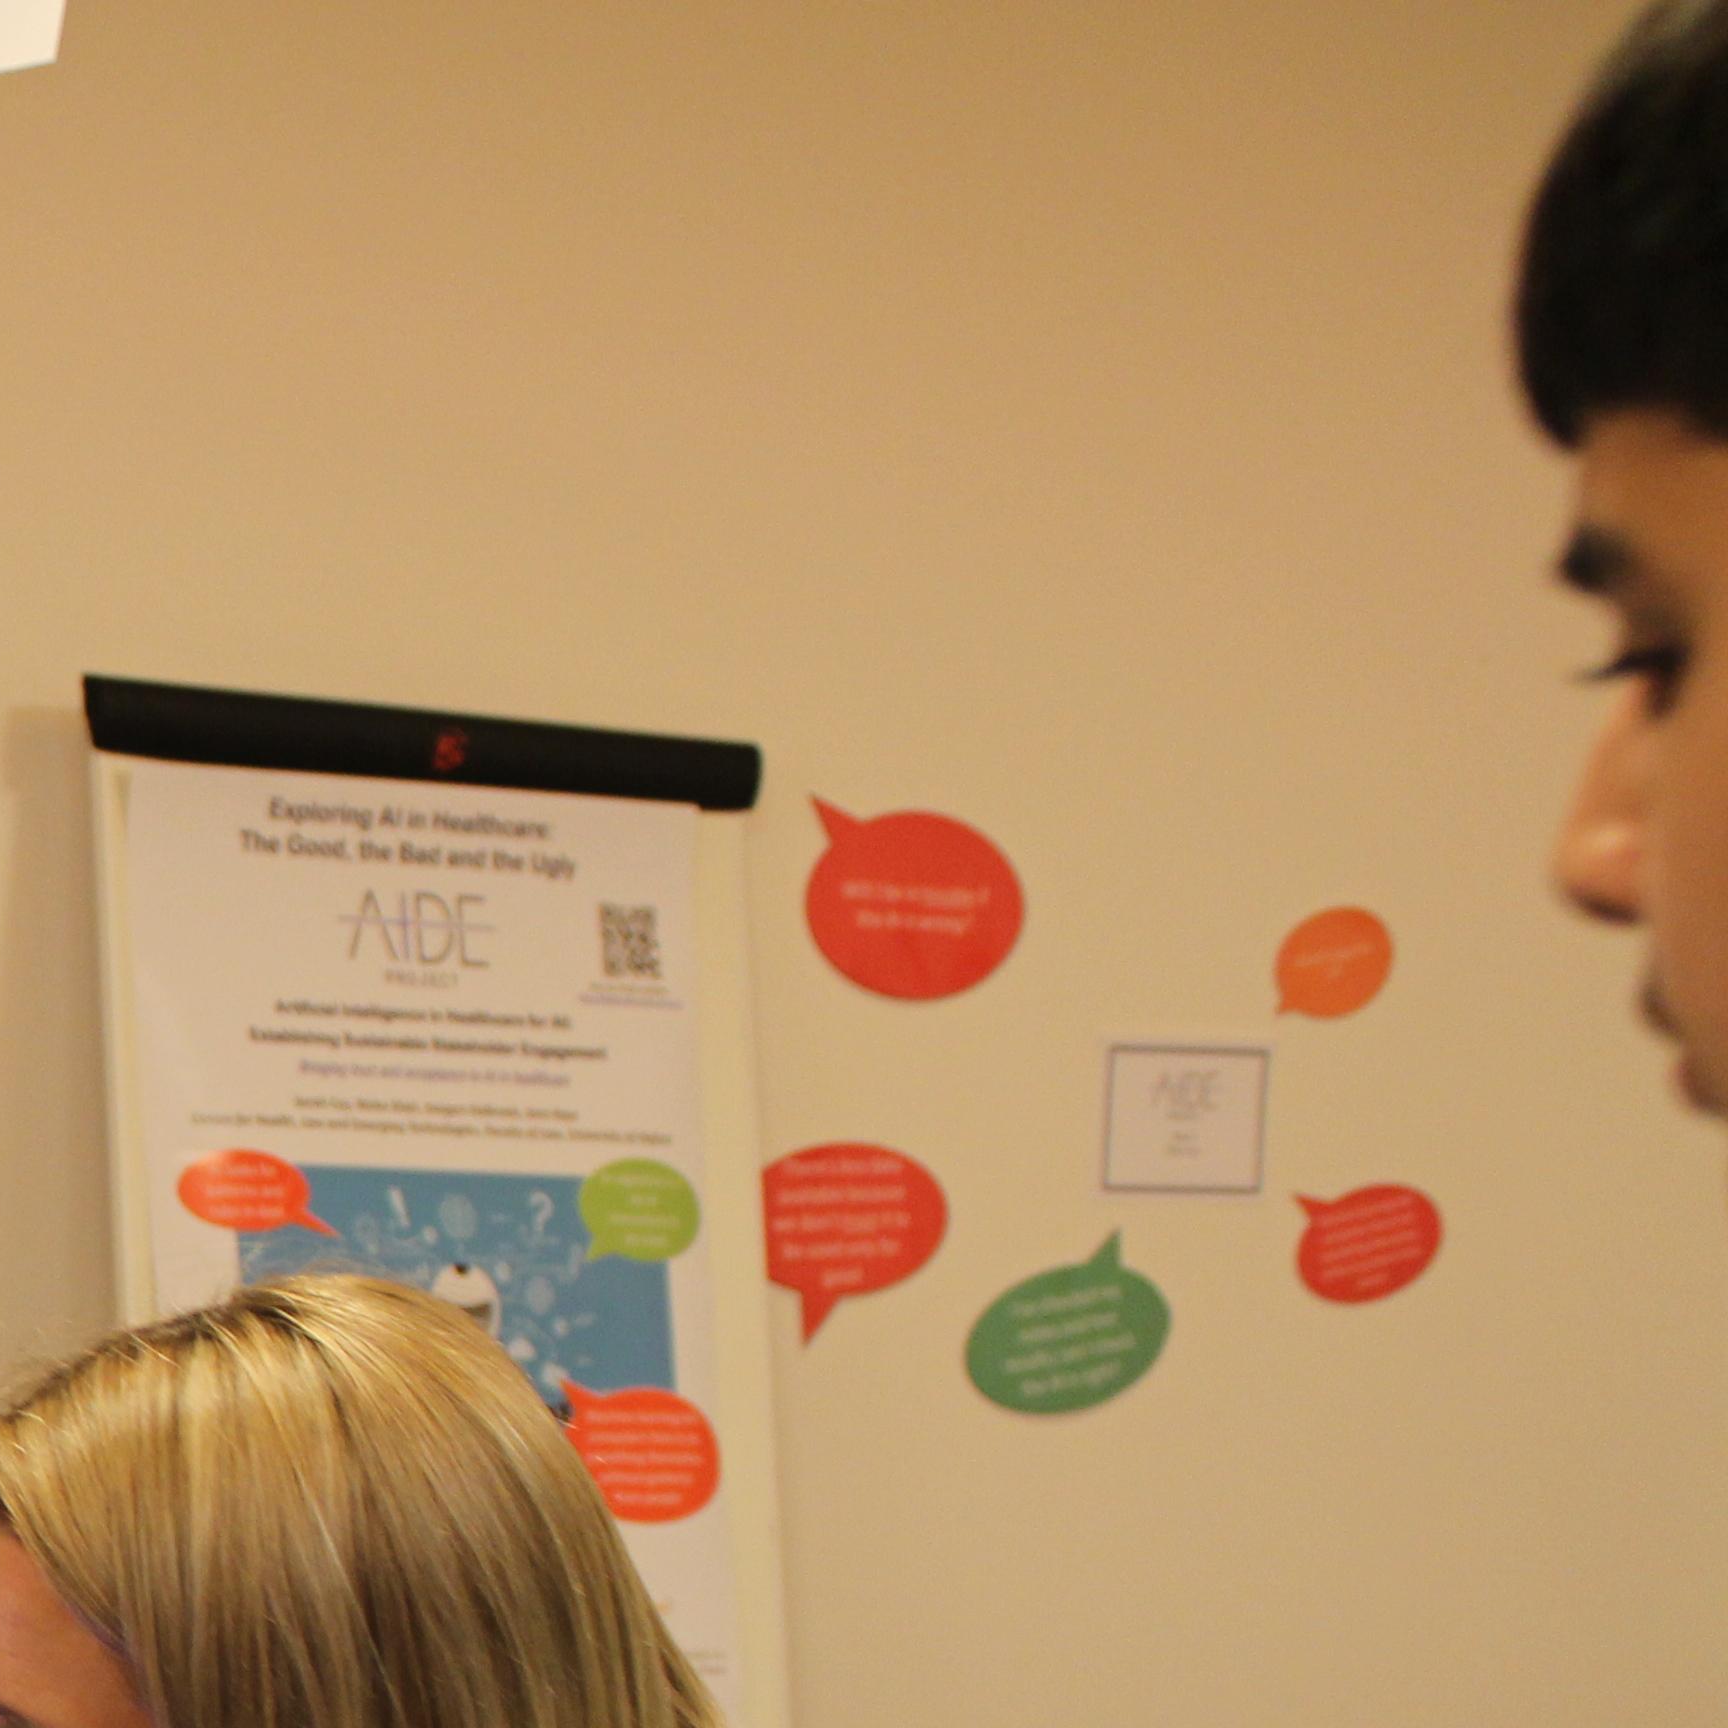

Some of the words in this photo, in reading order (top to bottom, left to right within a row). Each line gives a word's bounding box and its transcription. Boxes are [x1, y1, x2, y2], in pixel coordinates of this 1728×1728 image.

[270, 796, 373, 831] Exploring
[378, 806, 402, 827] AI
[407, 810, 427, 828] in
[241, 829, 280, 853] The
[359, 840, 392, 861] the
[400, 841, 440, 864] Bad
[447, 850, 485, 868] and
[493, 850, 524, 870] the
[531, 853, 575, 881] Ugly
[349, 889, 489, 967] AIDE
